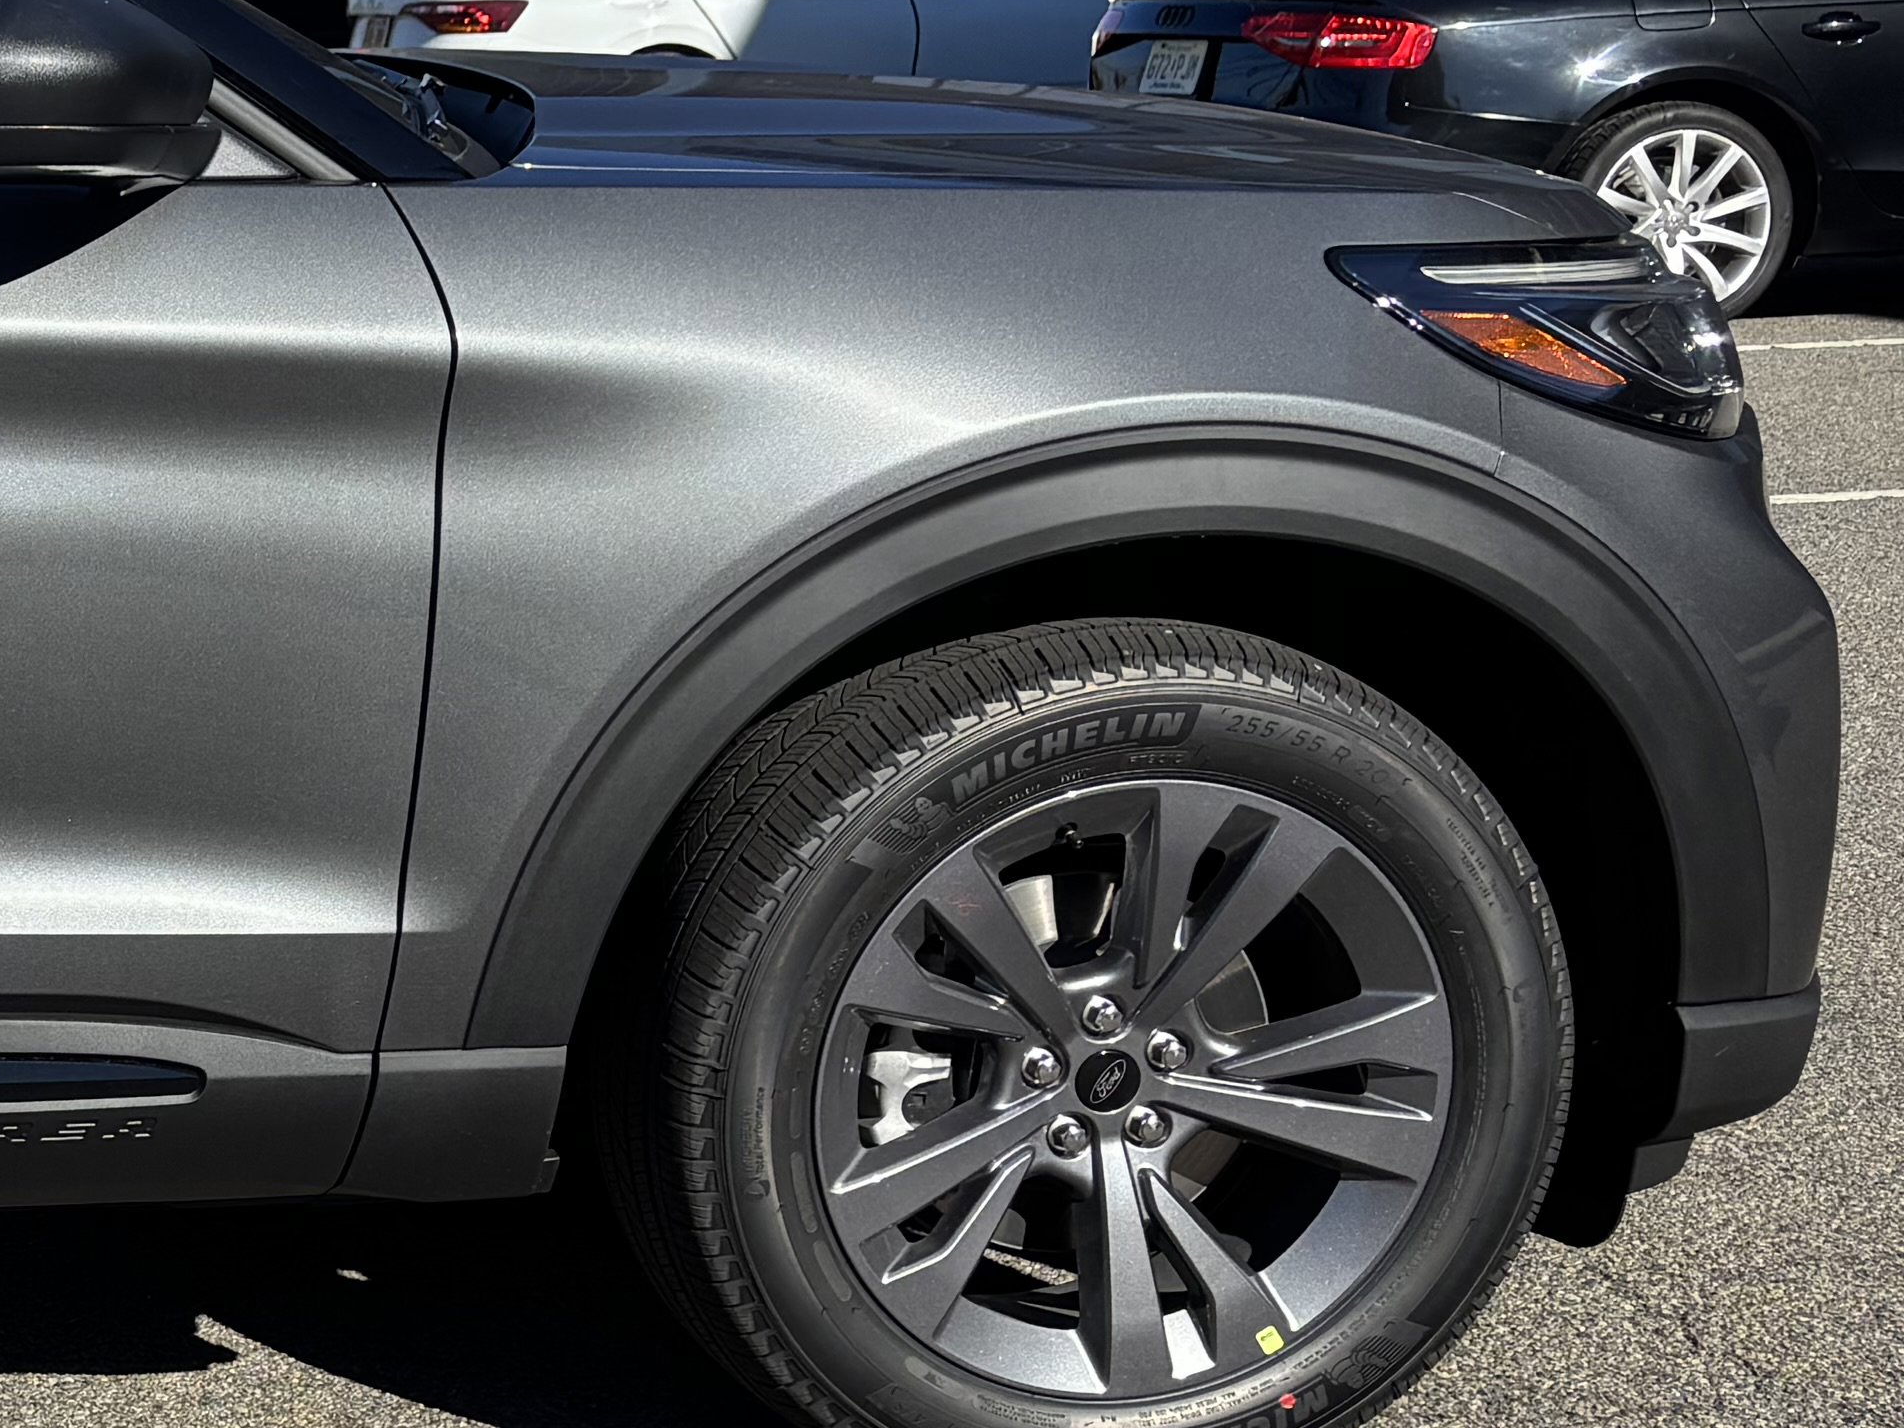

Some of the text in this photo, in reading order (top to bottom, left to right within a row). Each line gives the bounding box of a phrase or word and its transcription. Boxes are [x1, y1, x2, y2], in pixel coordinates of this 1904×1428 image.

[949, 711, 1187, 806] MICHELIN
[1224, 712, 1327, 754] 255/55
[1334, 743, 1352, 765] R
[1094, 1064, 1123, 1100] Ford
[752, 1087, 765, 1150] Performance
